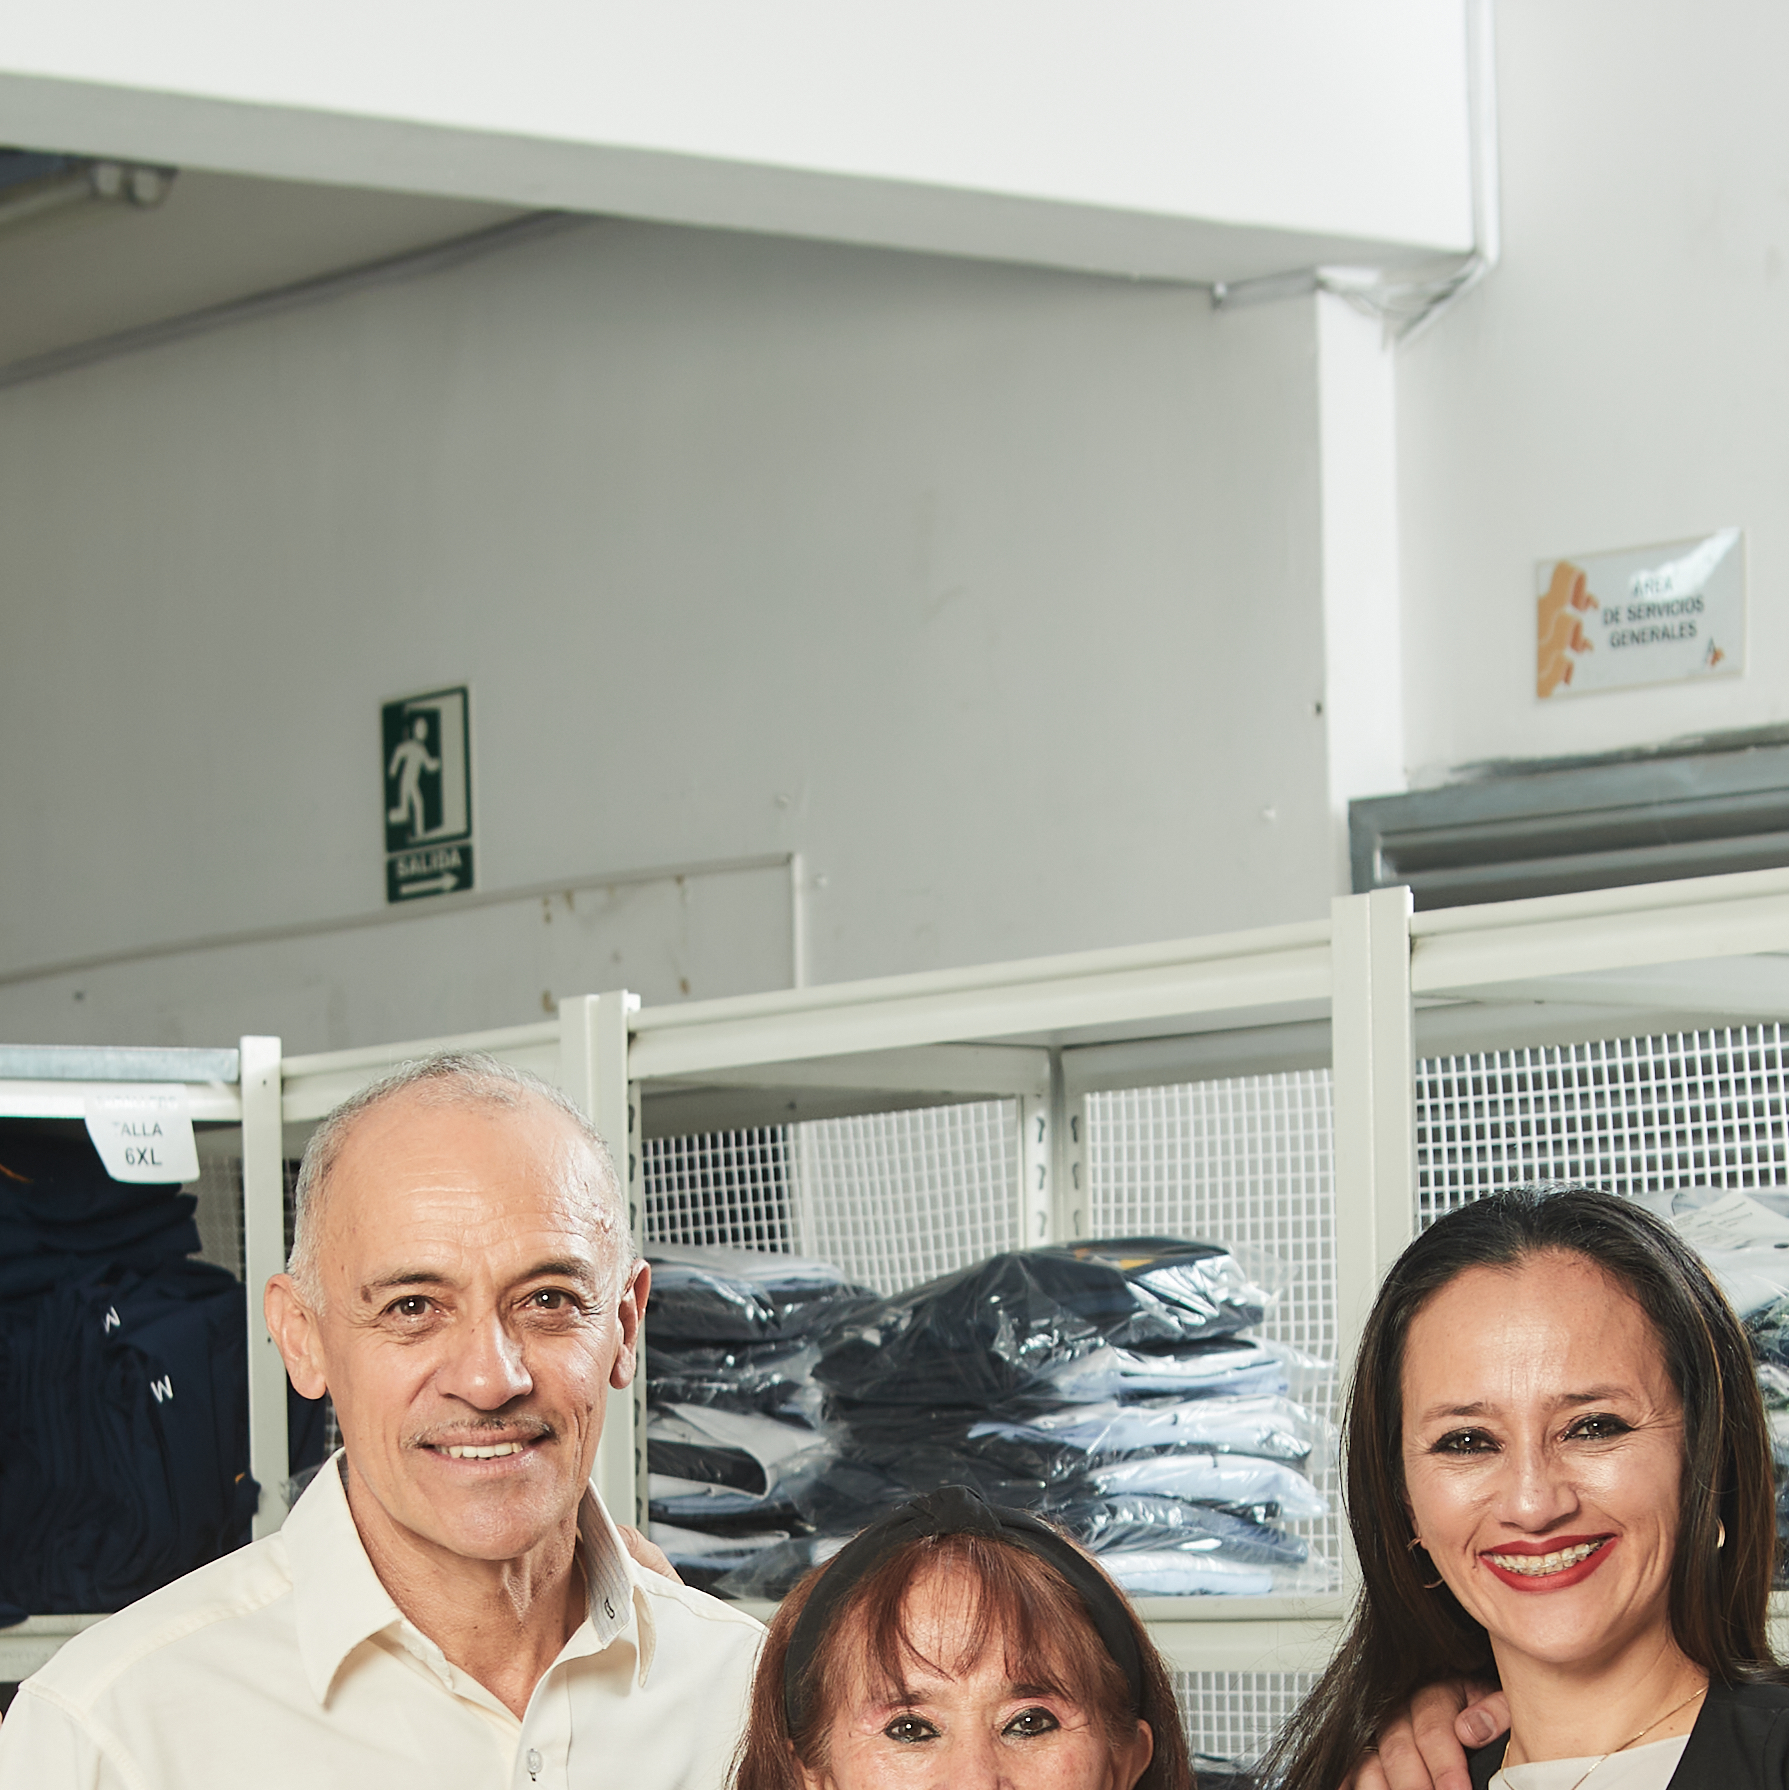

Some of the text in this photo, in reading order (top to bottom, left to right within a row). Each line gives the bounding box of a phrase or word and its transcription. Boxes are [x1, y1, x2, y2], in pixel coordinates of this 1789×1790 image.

[1603, 595, 1705, 626] DE SERVICIOS
[1610, 620, 1697, 649] GENERALES
[397, 846, 462, 879] SALIDA
[124, 1146, 162, 1167] 6XL
